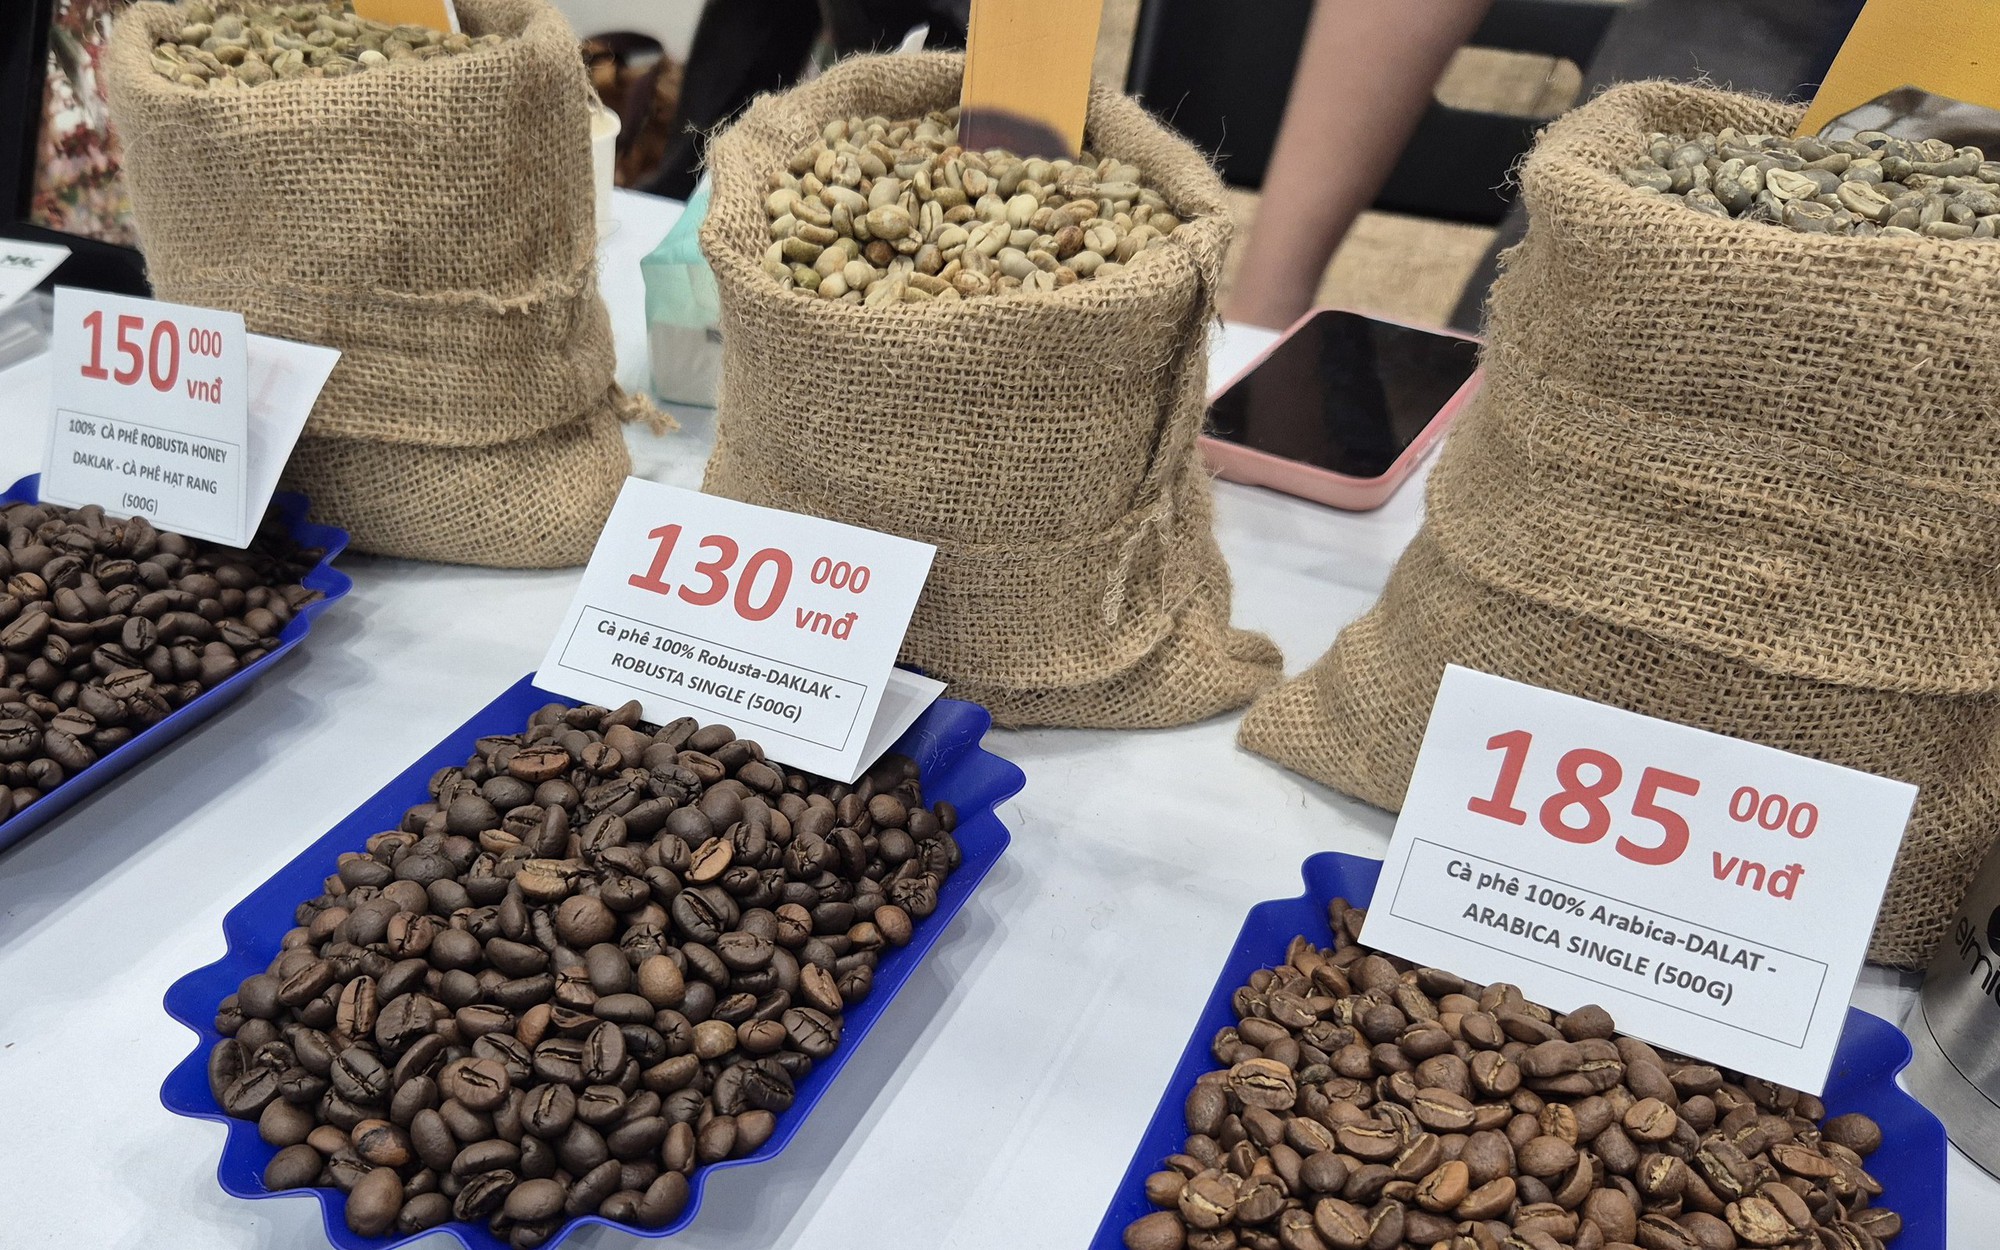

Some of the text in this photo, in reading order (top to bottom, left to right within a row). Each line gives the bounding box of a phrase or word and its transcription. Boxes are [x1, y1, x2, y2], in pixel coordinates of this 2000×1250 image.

[81, 310, 222, 392] 150 000
[187, 377, 223, 404] vnđ
[69, 419, 228, 464] 100% CÀ PHÊ ROBUSTA HONEY
[73, 450, 114, 472] DAKLAK
[122, 458, 137, 478] CÀ
[139, 464, 161, 482] PHÊ
[163, 470, 185, 488] HẠT
[187, 475, 218, 495] RANG
[122, 492, 159, 516] (500G)
[628, 524, 871, 622] 130 000
[597, 618, 617, 637] Cà
[616, 627, 651, 646] phê
[652, 636, 696, 660] 100%
[697, 648, 834, 700] Robusta-DAKLAK
[795, 607, 860, 641] vnđ
[611, 652, 803, 724] ROBUSTA SINGLE (500G)
[1467, 729, 1819, 867] 185 000
[1711, 851, 1806, 900] vnđ
[1446, 859, 1474, 883] Cà
[1476, 870, 1520, 899] phê
[1524, 883, 1587, 918] 100%
[1588, 904, 1766, 973] Arabica-DALAT
[1461, 902, 1734, 1007] ARABICA SINGLE (500G)
